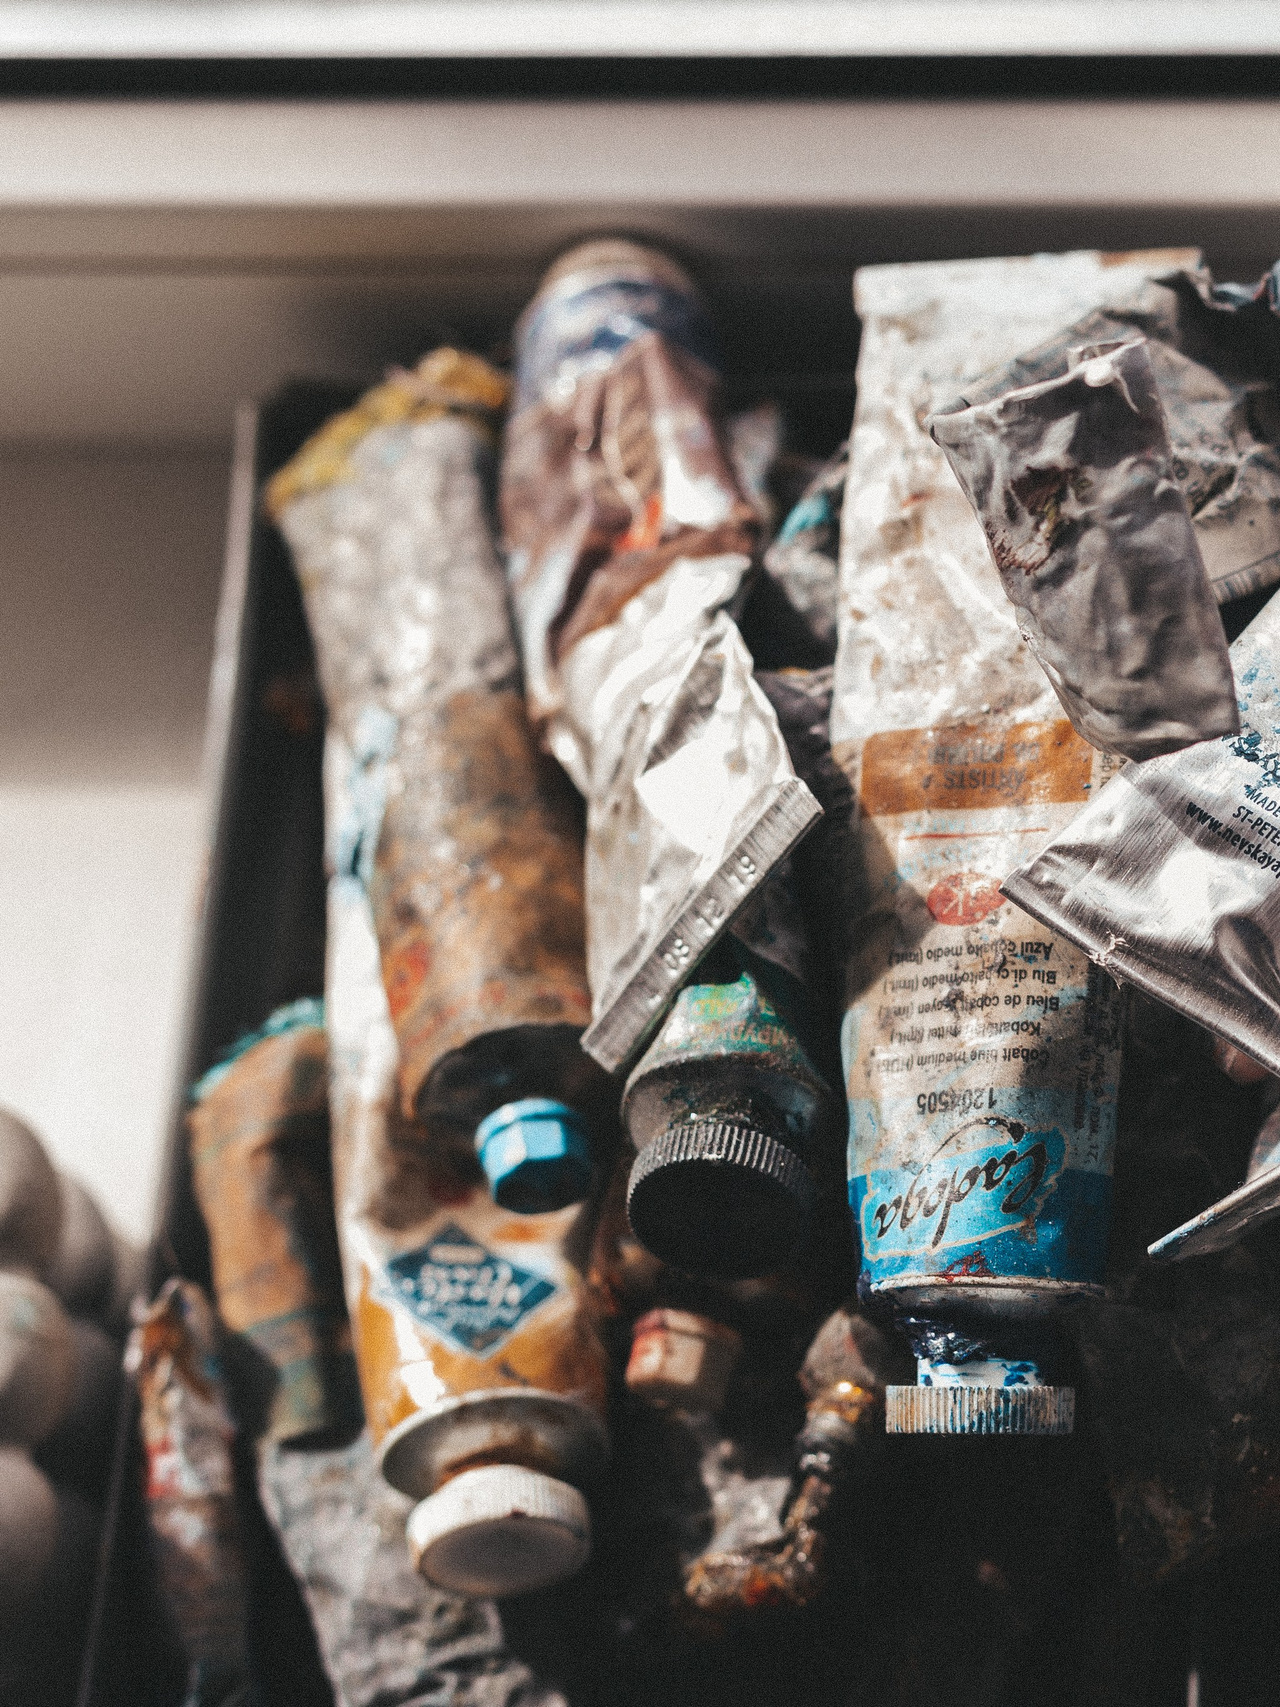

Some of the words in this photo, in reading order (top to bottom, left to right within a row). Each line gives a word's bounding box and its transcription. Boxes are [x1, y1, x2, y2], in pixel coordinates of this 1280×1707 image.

[925, 945, 963, 962] medio
[1020, 939, 1054, 962] Azul
[921, 972, 958, 989] medio
[960, 967, 1009, 984] cbalto
[1031, 967, 1057, 986] Blu
[917, 997, 955, 1014] oyen
[1003, 993, 1021, 1008] de
[1025, 992, 1060, 1013] Bleu
[916, 1050, 967, 1066] medium
[969, 1048, 998, 1063] blue
[1001, 1045, 1049, 1062] Cobalt
[914, 1086, 997, 1115] 1204505
[874, 1119, 1048, 1252] Ladoga
